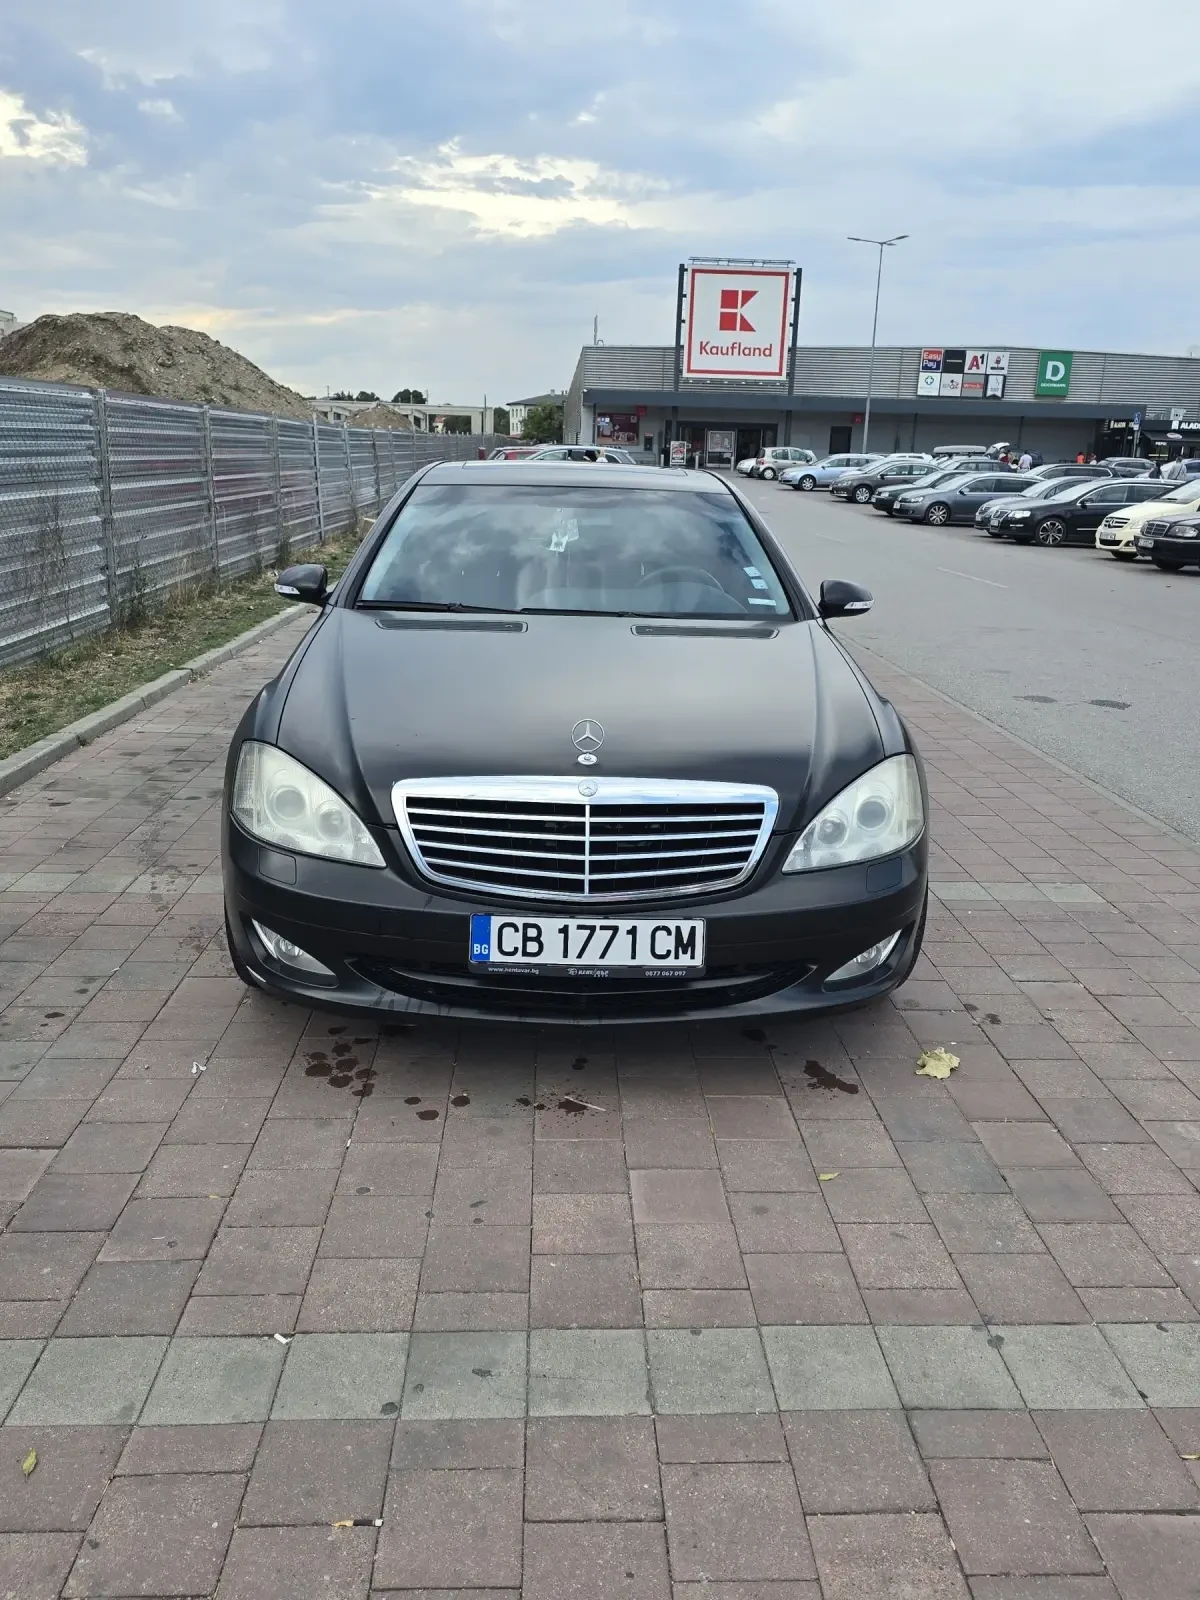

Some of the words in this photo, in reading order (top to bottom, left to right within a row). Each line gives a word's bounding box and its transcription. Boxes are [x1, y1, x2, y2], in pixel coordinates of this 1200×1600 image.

[699, 341, 773, 357] Kaufland
[923, 352, 941, 361] Easy
[923, 360, 937, 369] Pay
[968, 354, 985, 370] A1
[1045, 361, 1066, 381] D
[497, 922, 544, 957] CB
[557, 924, 638, 960] 1771
[650, 926, 697, 960] CM
[473, 944, 489, 955] BG
